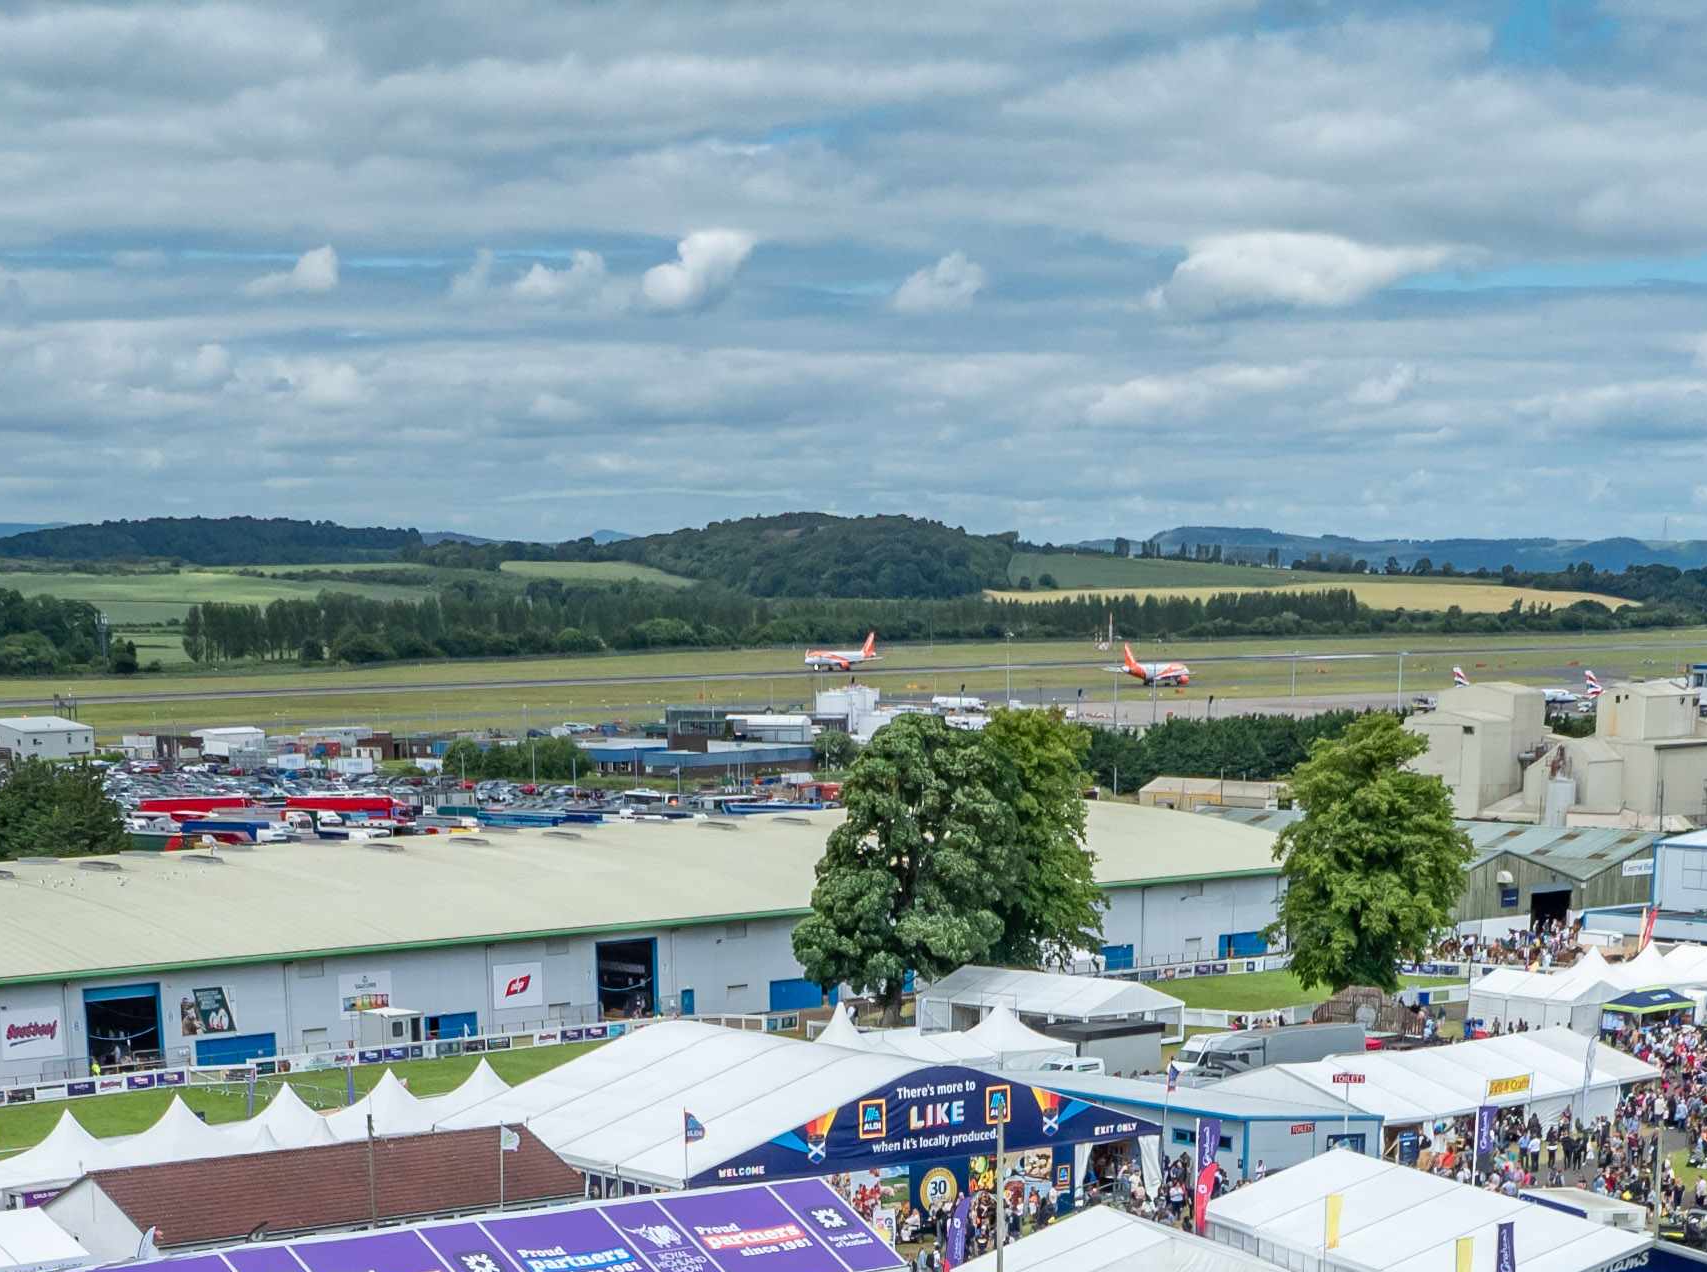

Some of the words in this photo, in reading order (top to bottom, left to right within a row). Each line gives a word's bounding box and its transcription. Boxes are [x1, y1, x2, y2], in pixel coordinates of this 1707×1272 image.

[7, 1019, 57, 1040] Scotbeef
[1334, 1074, 1365, 1083] TOILETS
[897, 1083, 934, 1099] There's
[937, 1083, 962, 1096] more
[965, 1080, 976, 1092] to
[909, 1101, 965, 1130] LIKE
[864, 1121, 881, 1131] ALDI
[1095, 1125, 1114, 1135] EXIT
[1292, 1123, 1315, 1134] TOILETS
[873, 1141, 900, 1153] when
[903, 1138, 918, 1150] it's
[920, 1132, 953, 1149] locally
[954, 1129, 999, 1146] produced.
[719, 1166, 765, 1178] WELCOME
[930, 1180, 947, 1196] 30
[694, 1223, 742, 1236] Proud
[704, 1224, 801, 1249] partners
[518, 1246, 568, 1259] Proud
[740, 1244, 779, 1258] since
[780, 1238, 813, 1252] 1981
